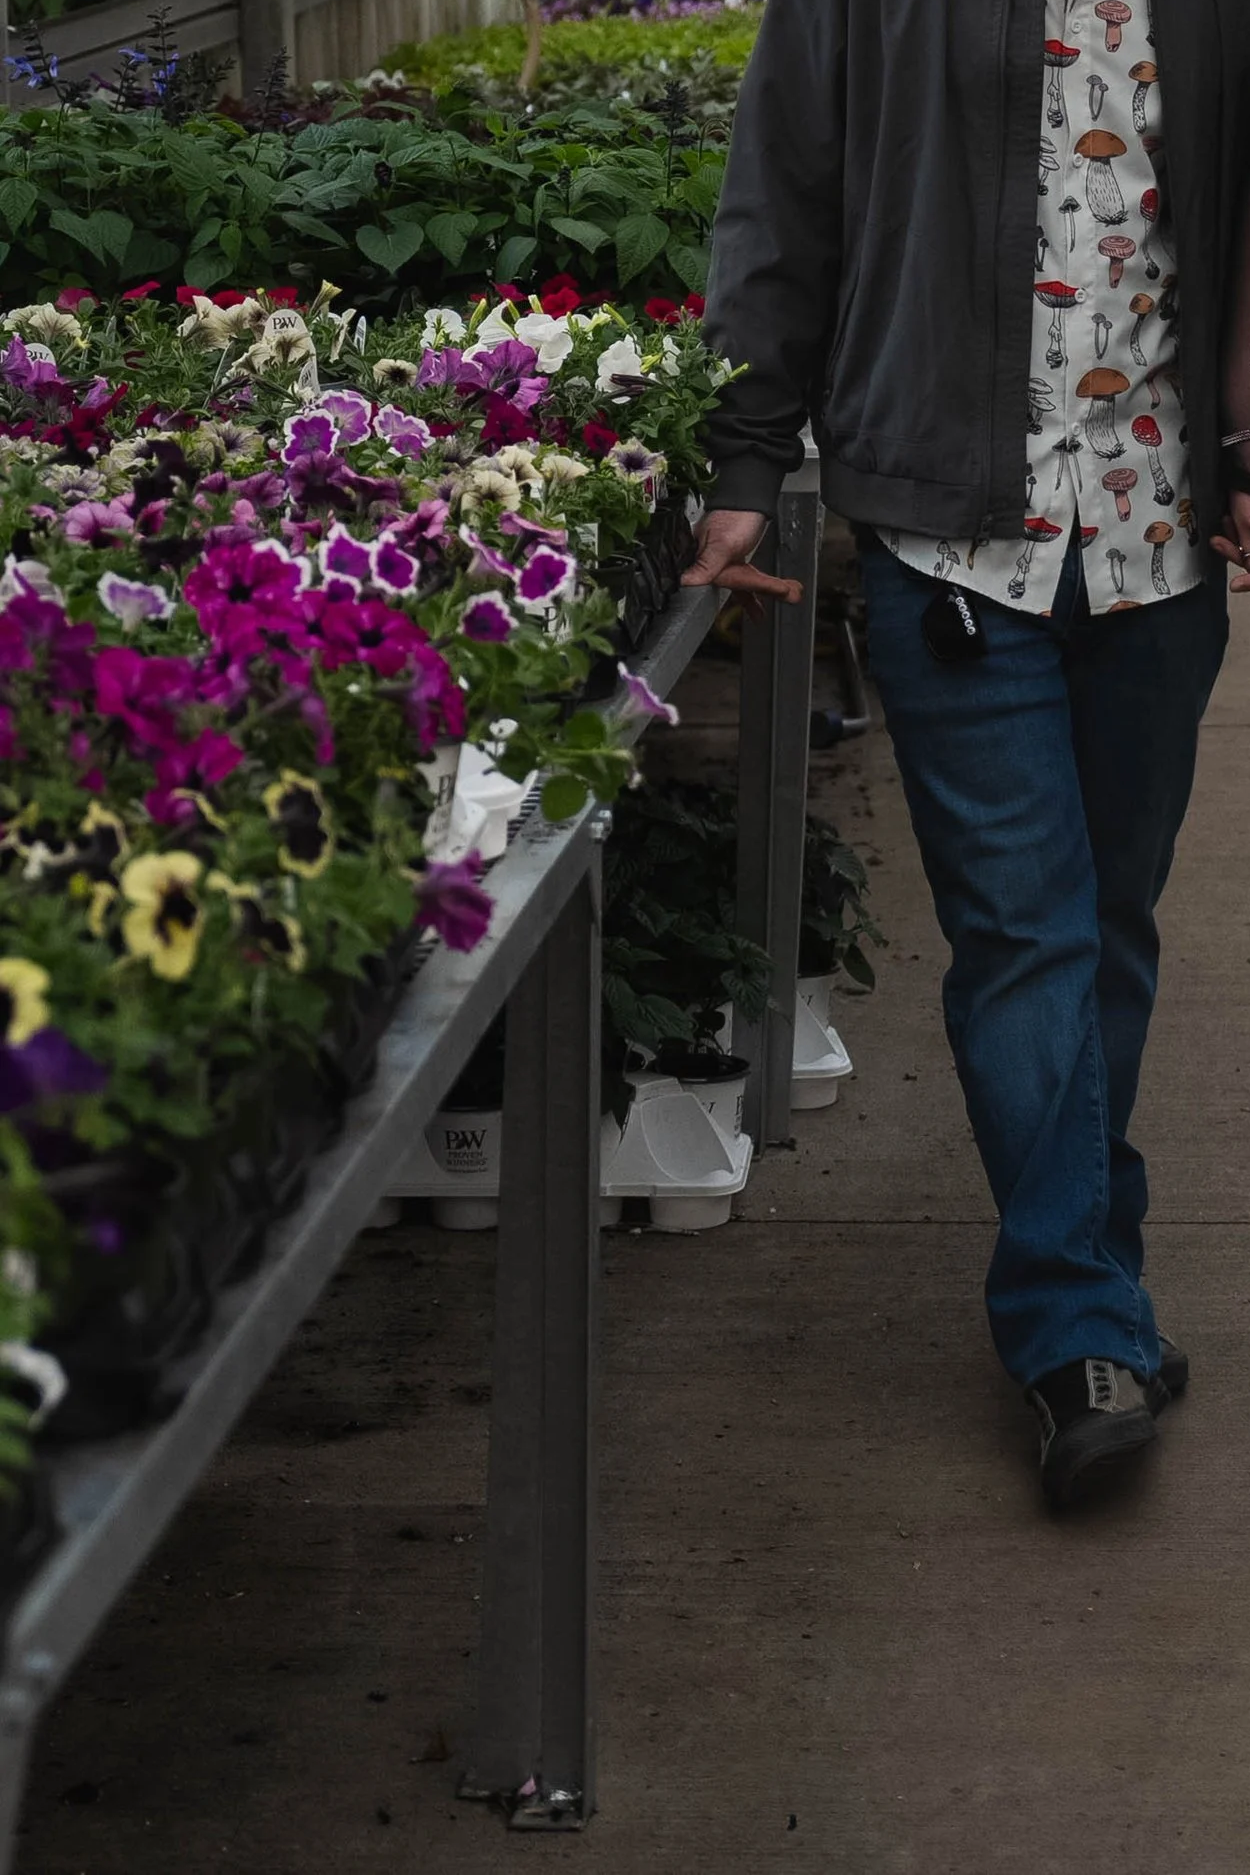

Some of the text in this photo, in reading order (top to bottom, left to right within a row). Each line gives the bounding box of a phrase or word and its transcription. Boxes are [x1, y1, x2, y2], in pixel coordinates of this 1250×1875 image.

[272, 316, 298, 330] PW
[444, 1129, 487, 1150] PW
[448, 1151, 483, 1159] PROVEN
